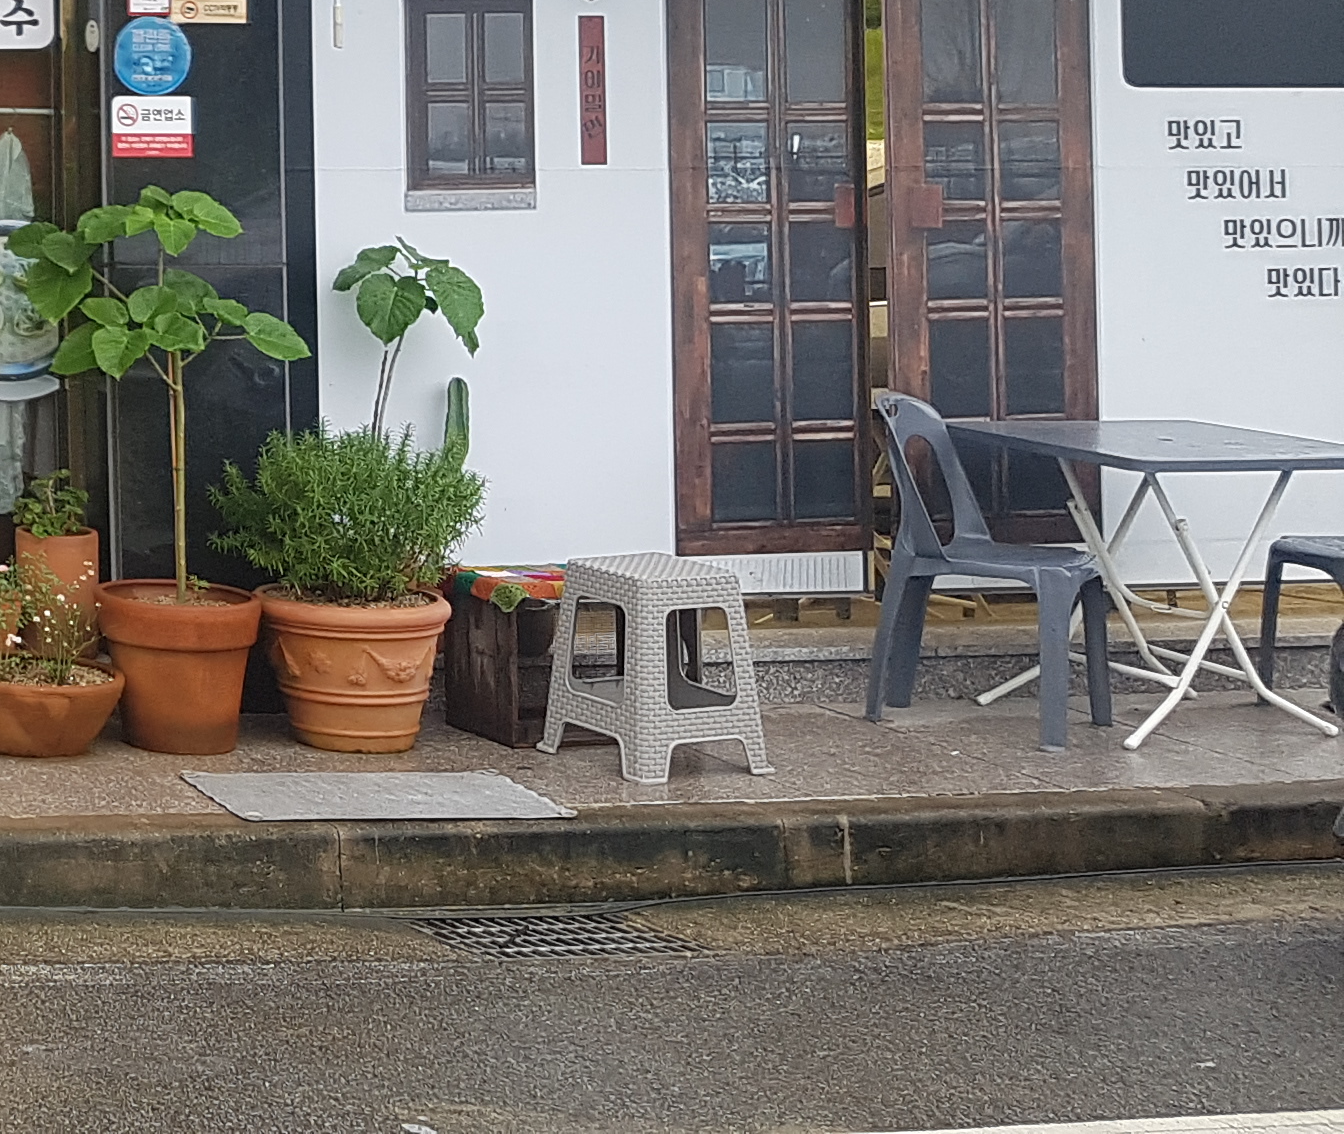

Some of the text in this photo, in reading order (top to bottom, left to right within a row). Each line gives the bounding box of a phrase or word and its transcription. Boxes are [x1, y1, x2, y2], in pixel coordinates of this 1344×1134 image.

[141, 108, 186, 122] 금연업소
[1167, 119, 1243, 150] 맛있고
[1186, 169, 1287, 200] 맛있어서
[1266, 267, 1341, 298] 맛있다
